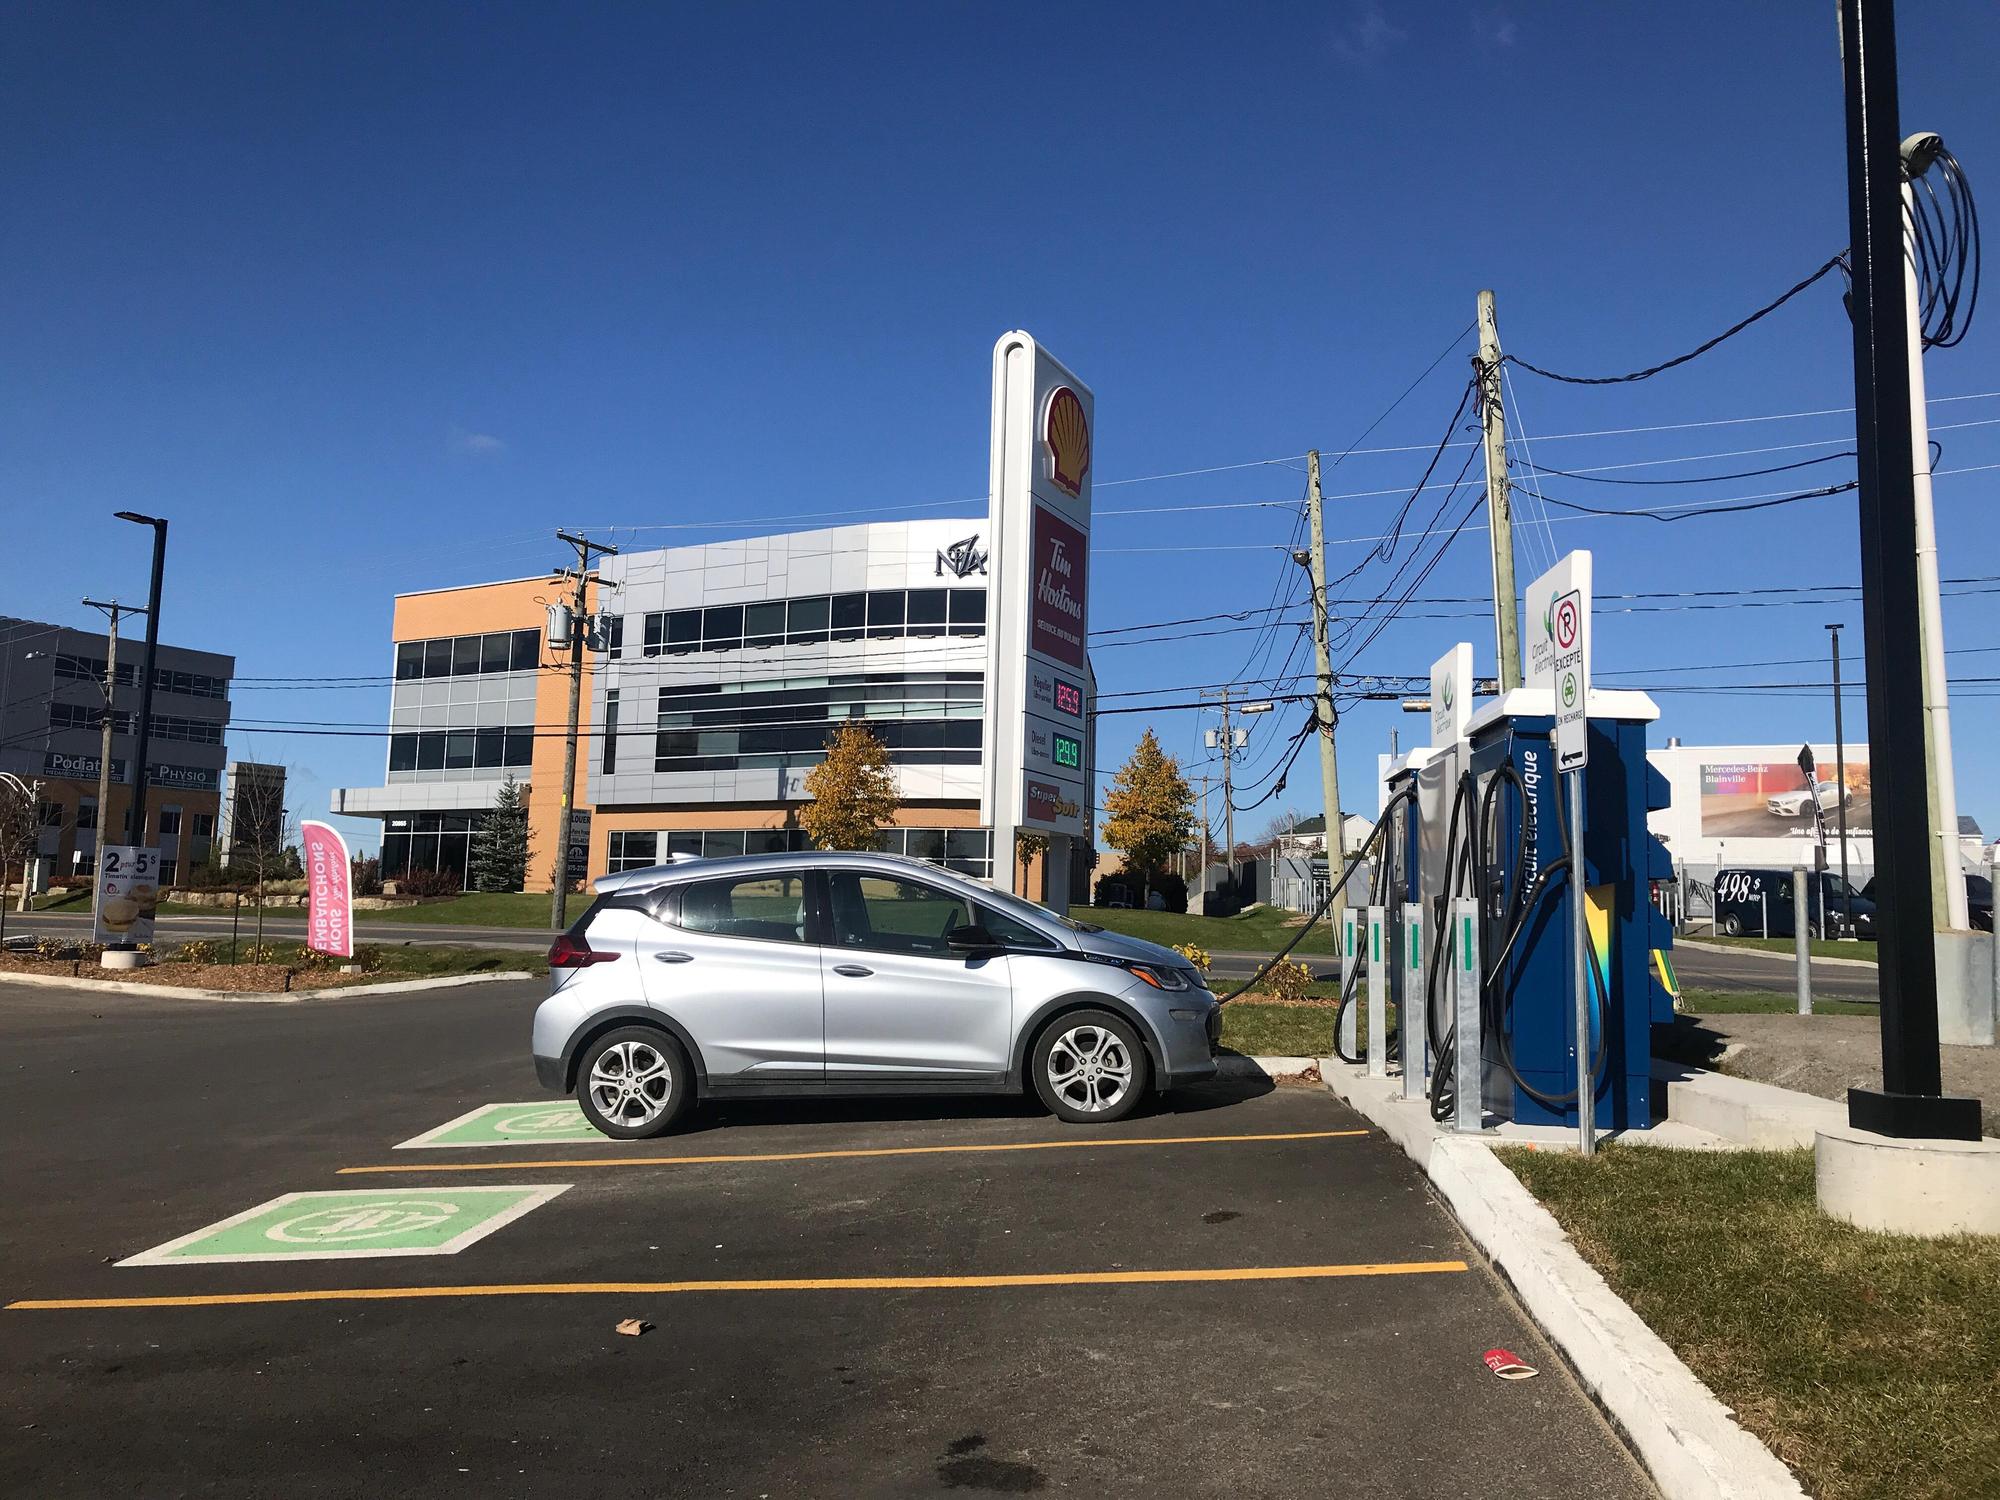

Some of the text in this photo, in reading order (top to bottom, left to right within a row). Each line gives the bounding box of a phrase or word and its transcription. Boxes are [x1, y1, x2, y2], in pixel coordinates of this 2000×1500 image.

[1049, 537, 1072, 578] Tim
[1038, 568, 1081, 619] Hortons
[1535, 654, 1555, 676] électriq
[1556, 647, 1582, 672] EXCEPTÉ
[1564, 709, 1583, 724] RECHARGE
[1056, 738, 1078, 767] 129.9
[53, 754, 115, 773] Podiate
[1705, 764, 1769, 774] Mercedes-Benz
[1705, 775, 1746, 783] Blainville
[105, 852, 120, 872] 2
[136, 854, 148, 873] 5
[150, 855, 157, 865] $
